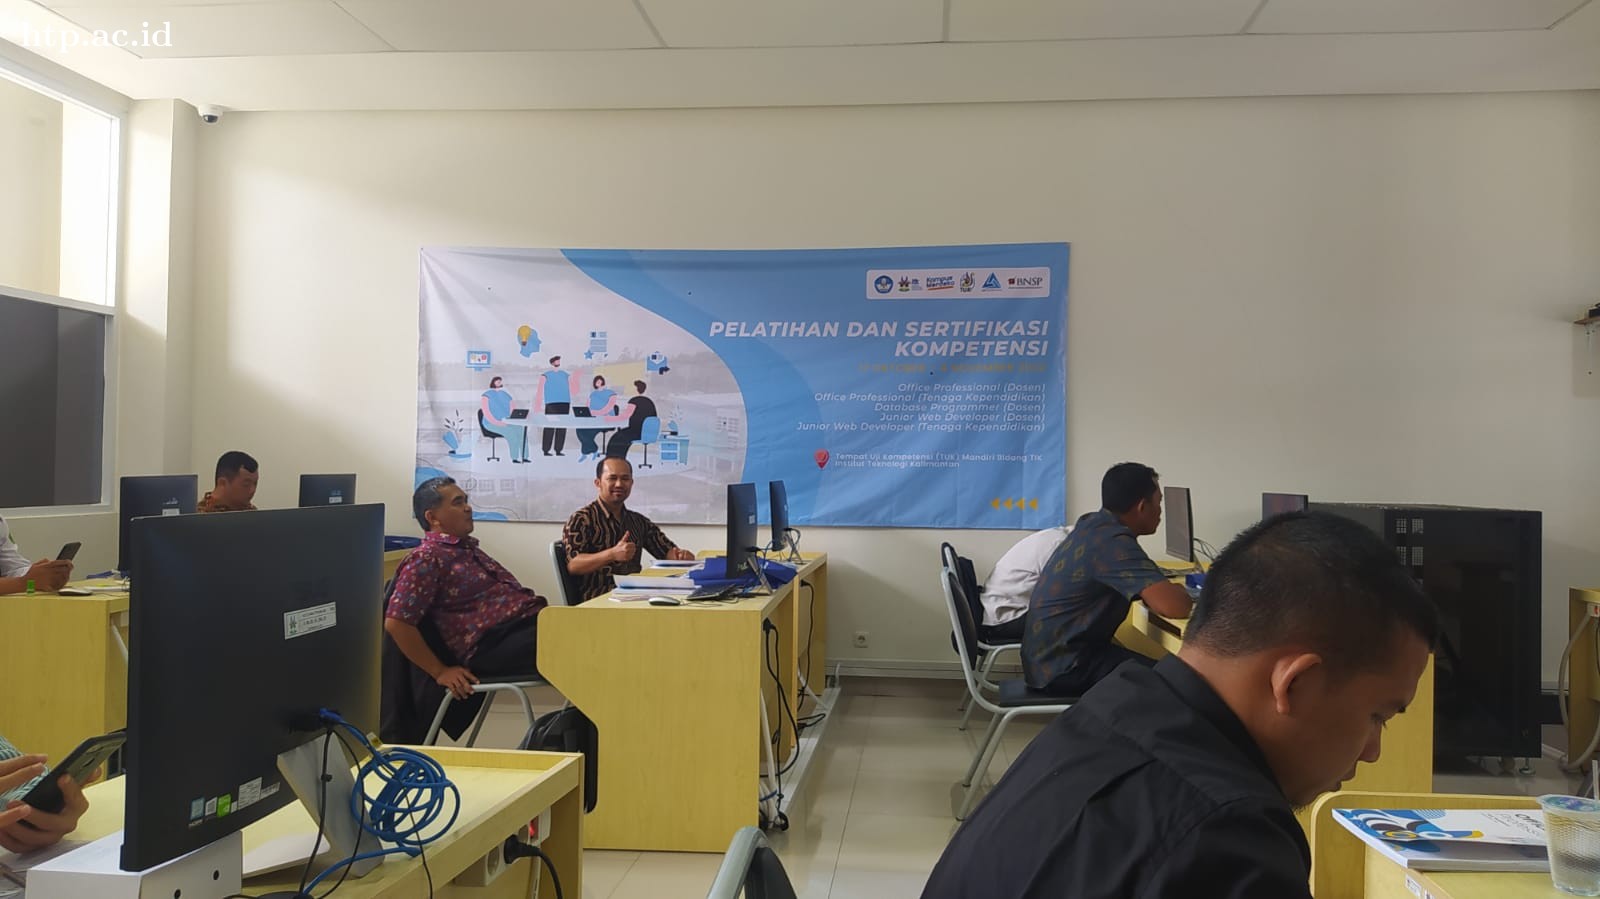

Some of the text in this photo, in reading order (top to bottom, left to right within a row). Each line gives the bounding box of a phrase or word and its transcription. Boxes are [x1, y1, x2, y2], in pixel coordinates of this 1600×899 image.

[1016, 277, 1043, 286] BNSP
[709, 320, 1049, 338] PELATIHAN DAN SERTIFIKASI
[894, 340, 1049, 357] KOMPETENSI
[898, 383, 1046, 393] Office Professional (Dosen)
[814, 392, 1046, 402] Office Professional (Tenaga Kependidikan)
[874, 402, 1046, 413] Database Programmer (Dosen)
[879, 412, 1046, 423] Junior Web Developer (Dosen)
[796, 421, 1046, 432] Junior Web Developer (Tenaga Kependidikan)
[836, 452, 867, 461] Tempat
[868, 461, 908, 469] Teknologi
